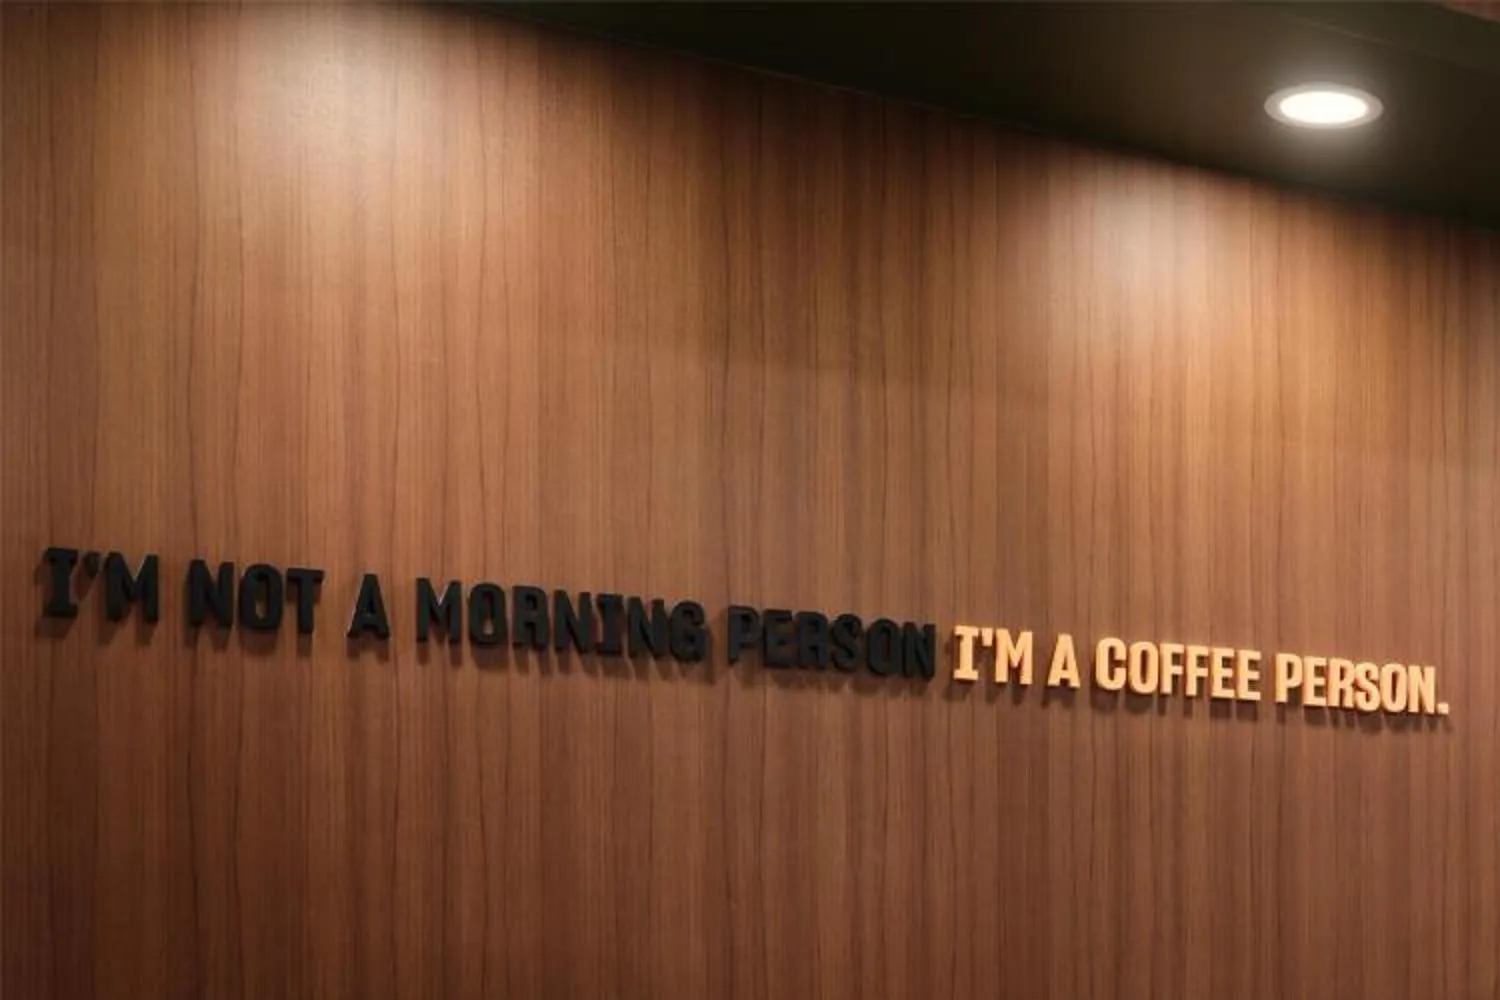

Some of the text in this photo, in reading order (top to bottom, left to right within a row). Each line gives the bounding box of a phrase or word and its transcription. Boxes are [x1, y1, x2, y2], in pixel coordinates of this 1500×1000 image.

[43, 546, 1449, 716] I'M NOT A MORNING PERSON I'M A COFFEE PERSON.
